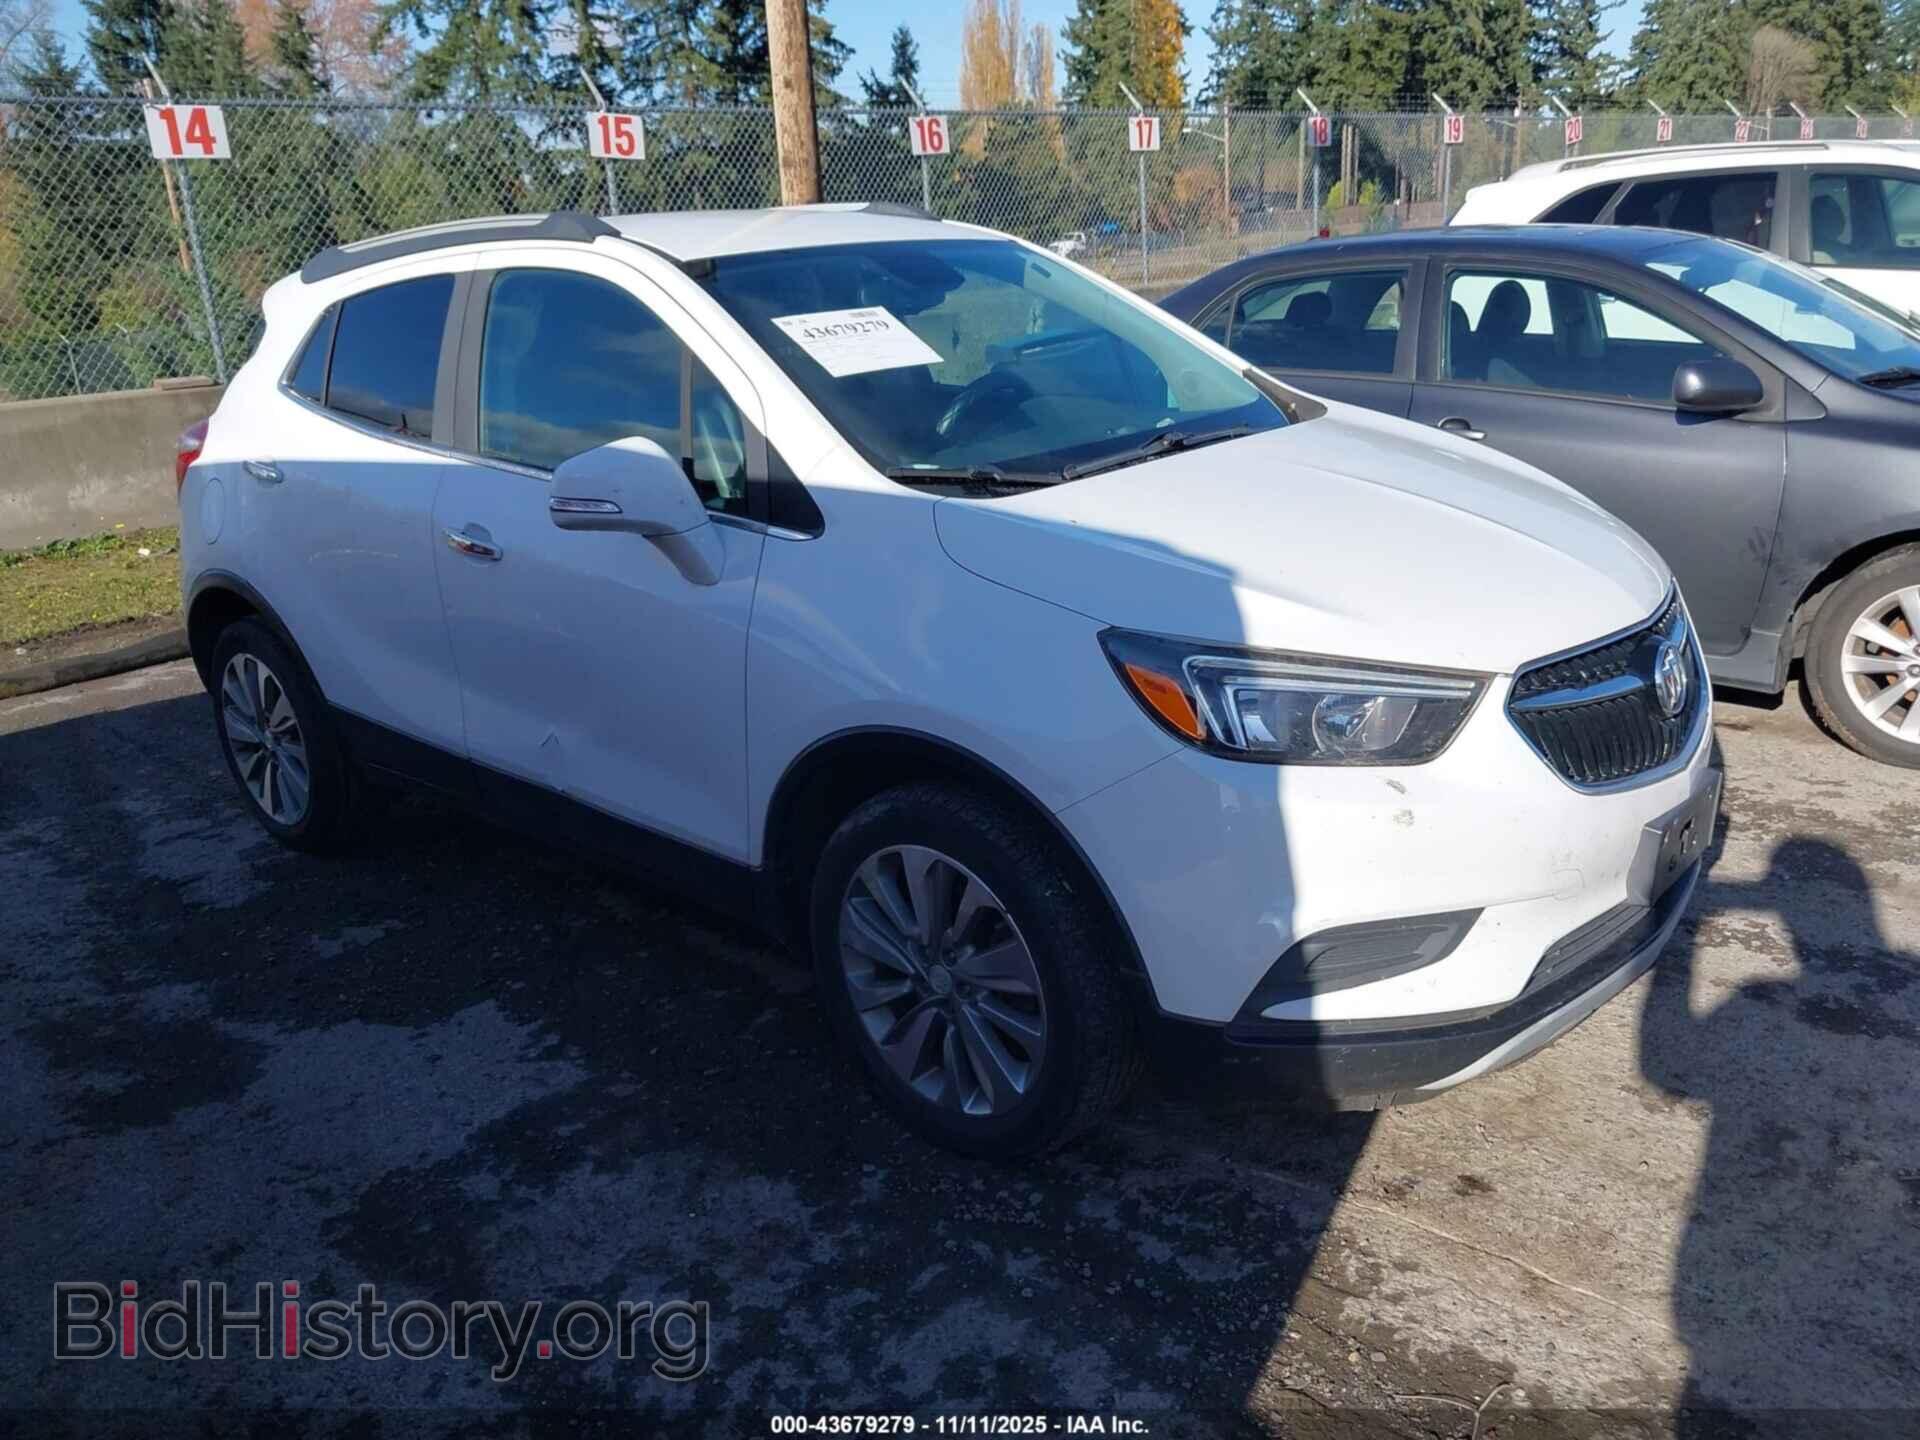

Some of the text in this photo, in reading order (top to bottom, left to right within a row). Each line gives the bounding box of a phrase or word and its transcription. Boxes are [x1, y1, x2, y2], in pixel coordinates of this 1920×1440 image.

[160, 106, 216, 155] 14
[598, 115, 635, 156] 15
[916, 118, 943, 152] 16
[1136, 119, 1153, 148] 17
[1312, 118, 1328, 144] 18
[1448, 117, 1461, 141] 19
[1567, 119, 1581, 142] 20
[1659, 119, 1671, 140] 21
[802, 320, 890, 339] 43679279
